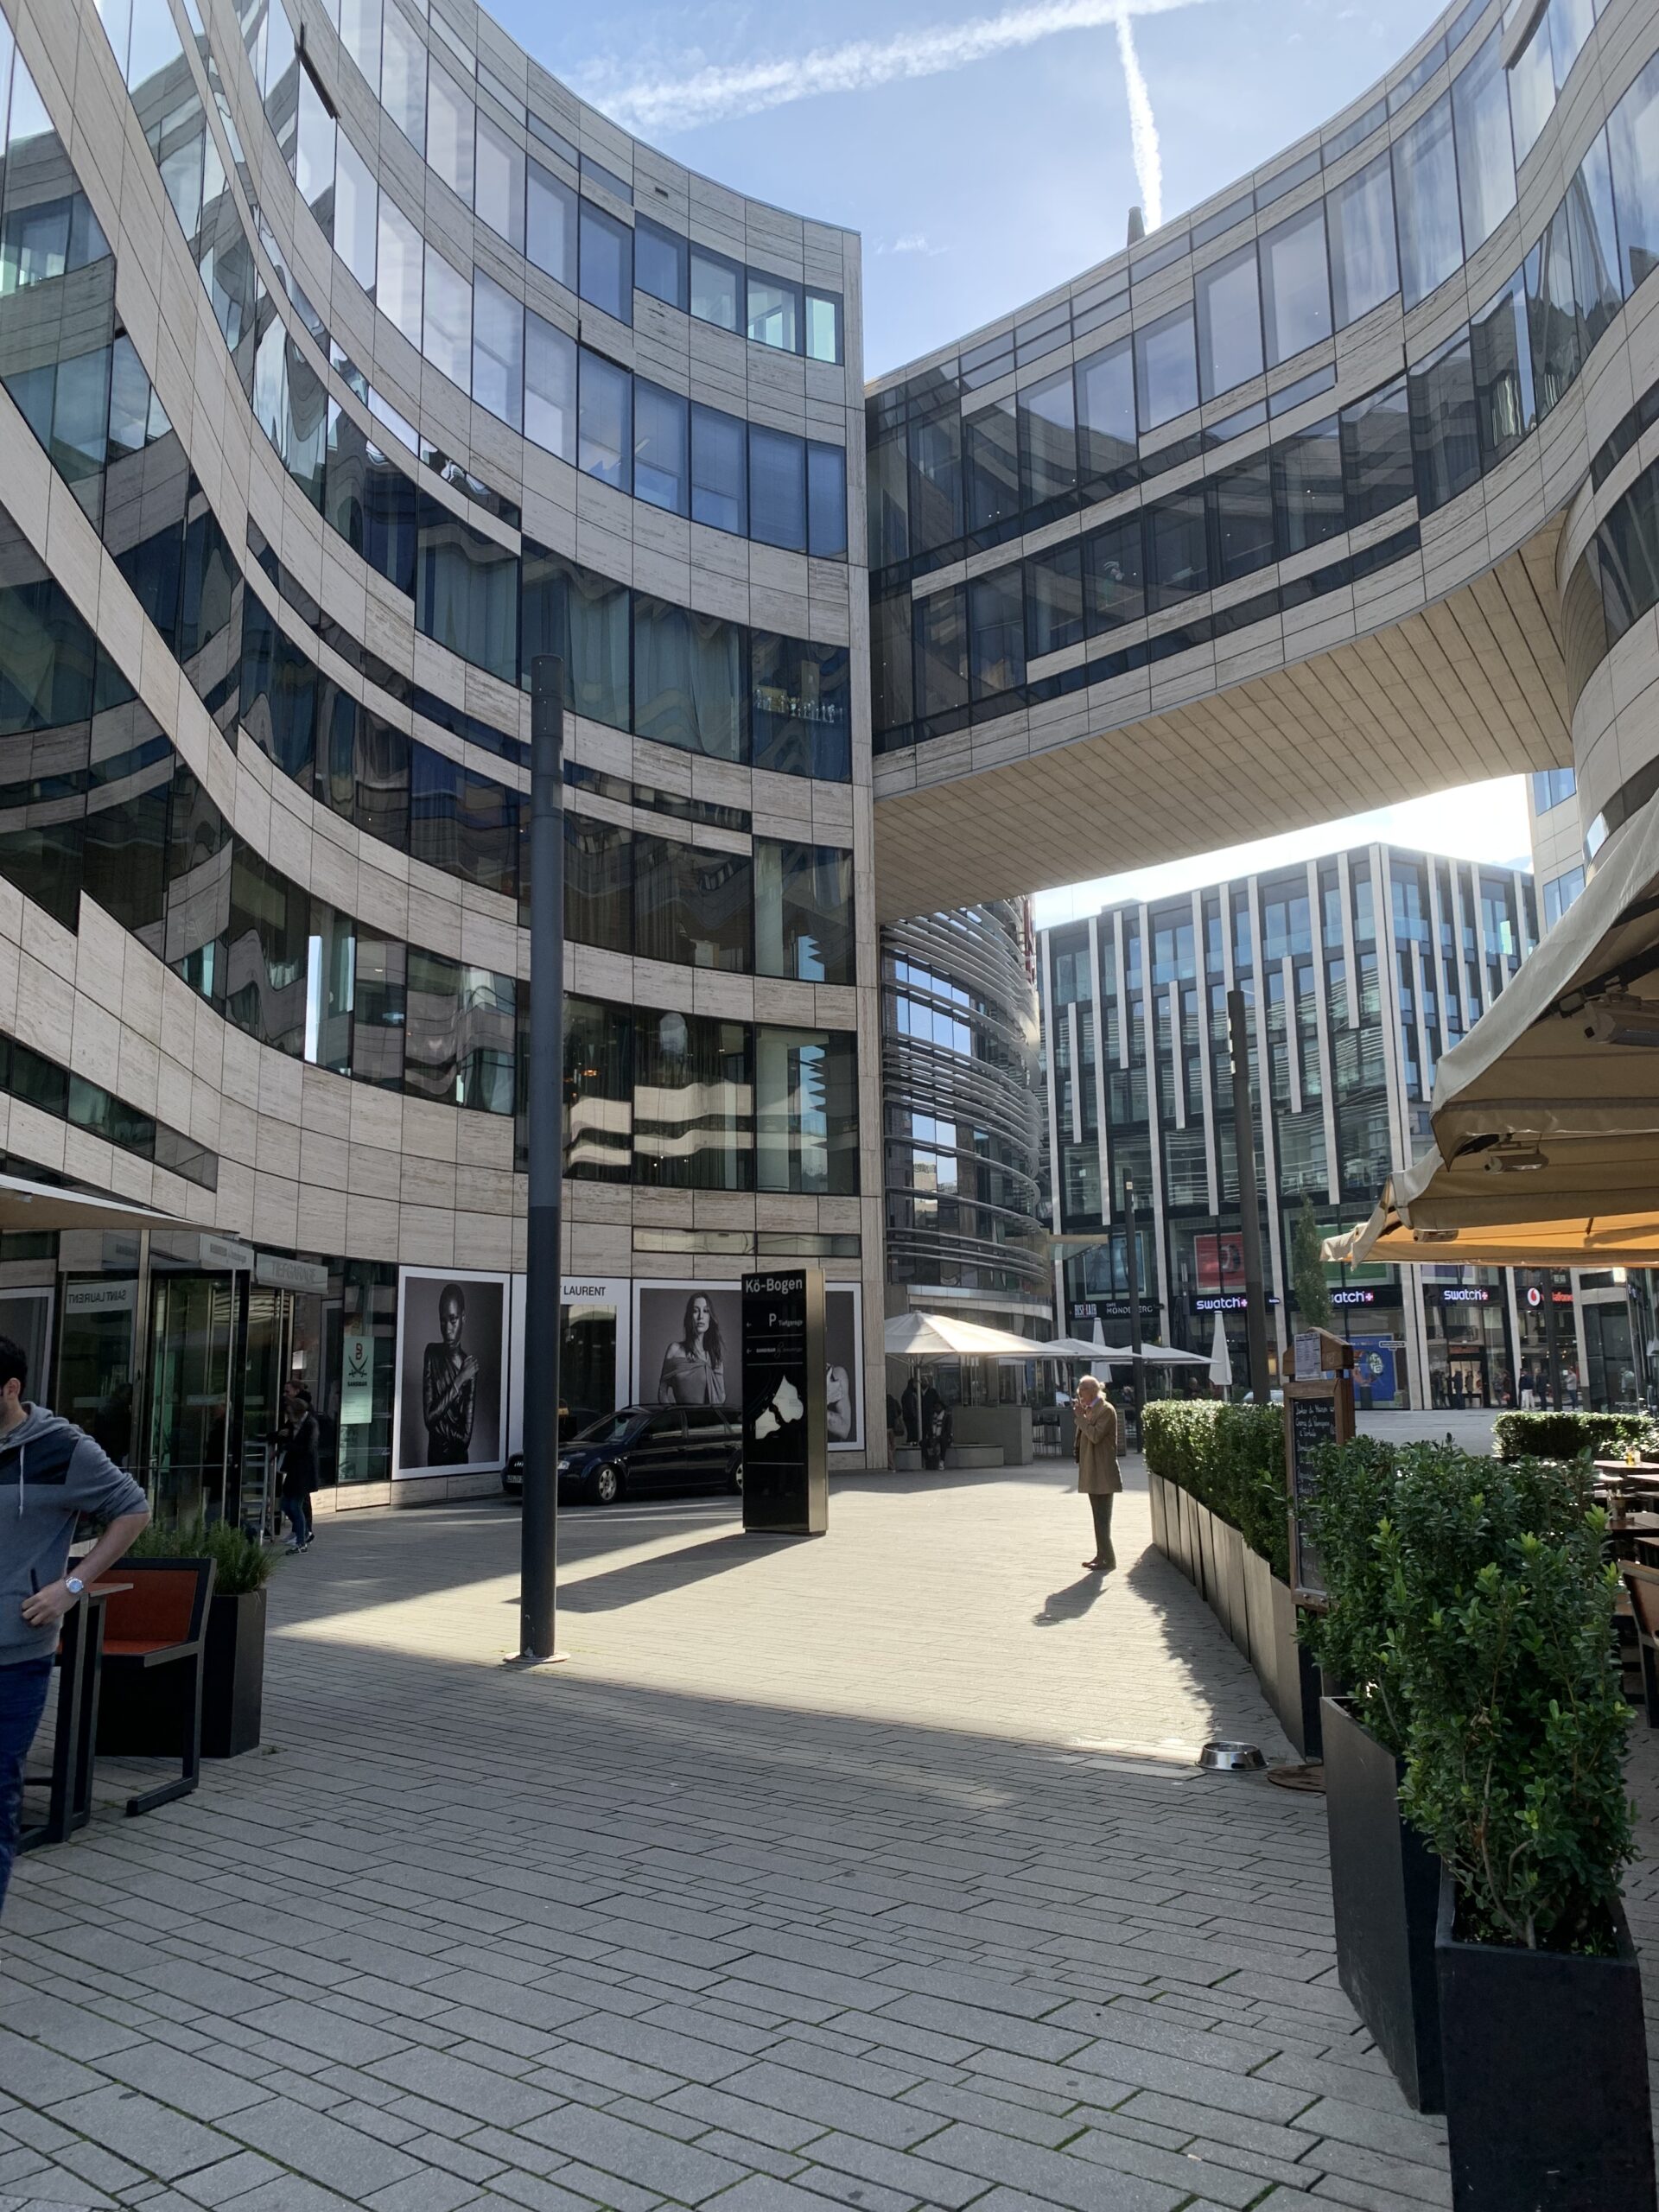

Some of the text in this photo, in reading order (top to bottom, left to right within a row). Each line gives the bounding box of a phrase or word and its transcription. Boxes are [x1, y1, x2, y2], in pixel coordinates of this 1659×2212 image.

[563, 1285, 607, 1296] LAURENT
[746, 1278, 803, 1294] Kö-Bogen
[1444, 1289, 1482, 1301] swatch
[1196, 1296, 1241, 1310] swatch
[768, 1313, 777, 1327] P
